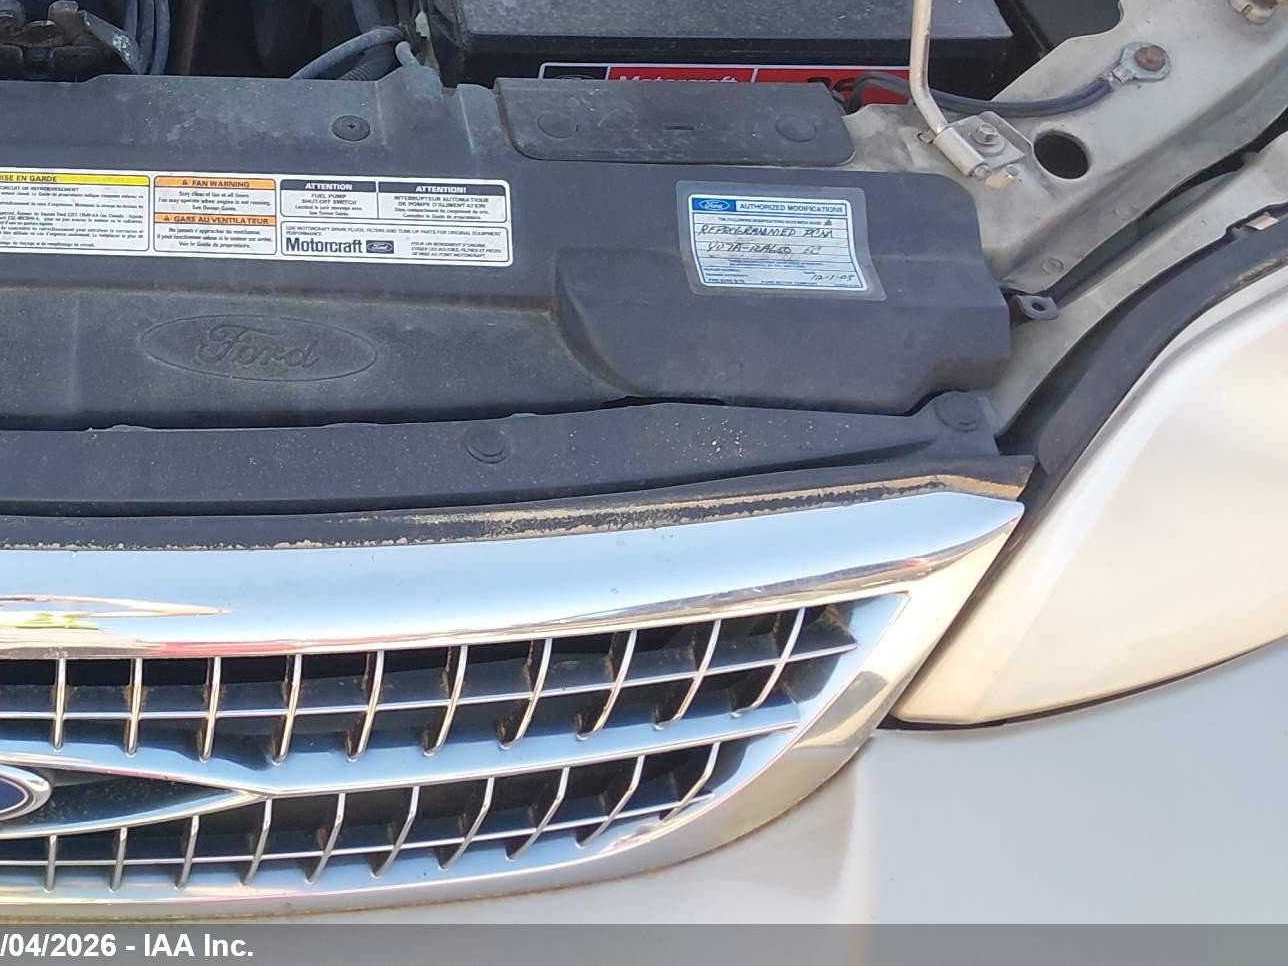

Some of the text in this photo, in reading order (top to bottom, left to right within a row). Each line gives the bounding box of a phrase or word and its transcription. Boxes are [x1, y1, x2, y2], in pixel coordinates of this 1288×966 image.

[305, 183, 353, 191] ATTENTION
[415, 185, 467, 193] ATTENTION!
[432, 201, 486, 209] D'ALIMENTATION
[702, 201, 843, 213] Ford AUTHORIZED MODIFICATIONS
[211, 216, 269, 224] VENTILATEUR
[286, 237, 363, 254] Motorcraft
[196, 324, 319, 368] Ford
